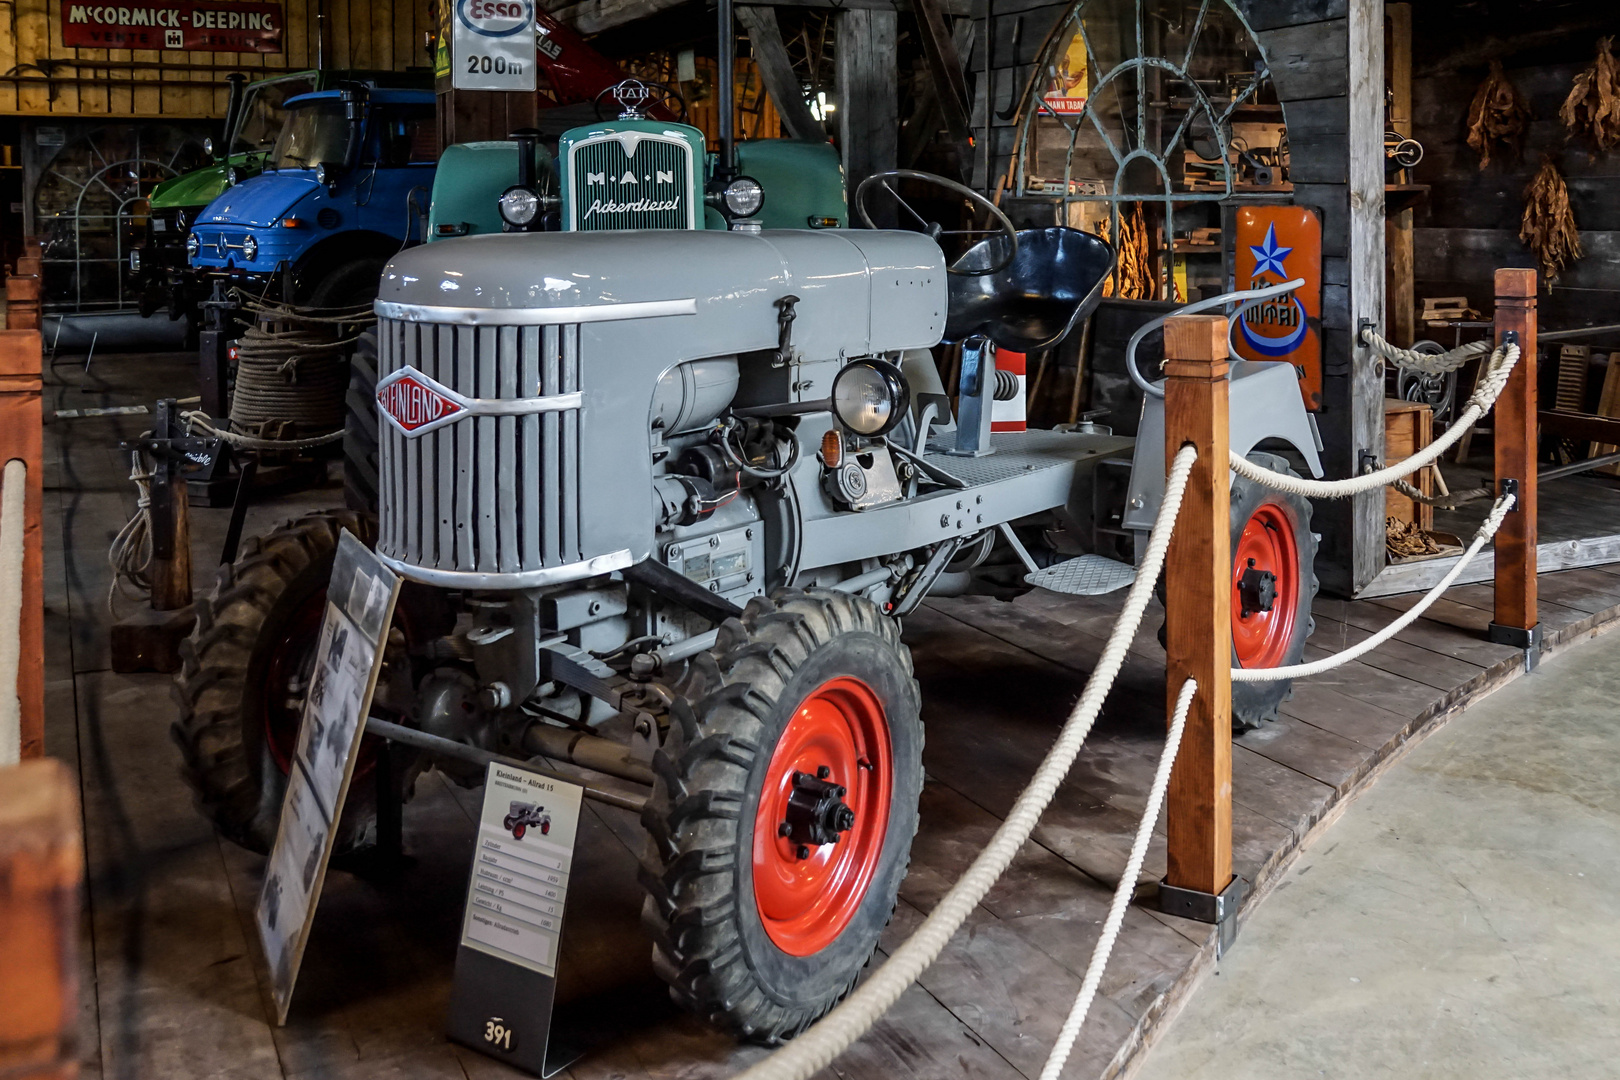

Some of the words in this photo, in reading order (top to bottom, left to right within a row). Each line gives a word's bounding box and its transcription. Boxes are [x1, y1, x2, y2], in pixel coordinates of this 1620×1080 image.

[470, 0, 522, 19] Esso
[90, 31, 149, 43] VENTE
[468, 55, 522, 75] 200m
[613, 87, 649, 98] MAN
[584, 196, 680, 220] Ackerdiesel
[381, 384, 443, 424] KLEINLAND
[496, 769, 522, 783] Kleinland
[528, 778, 546, 790] Allrad
[547, 784, 554, 792] 15
[485, 1021, 512, 1049] 391
